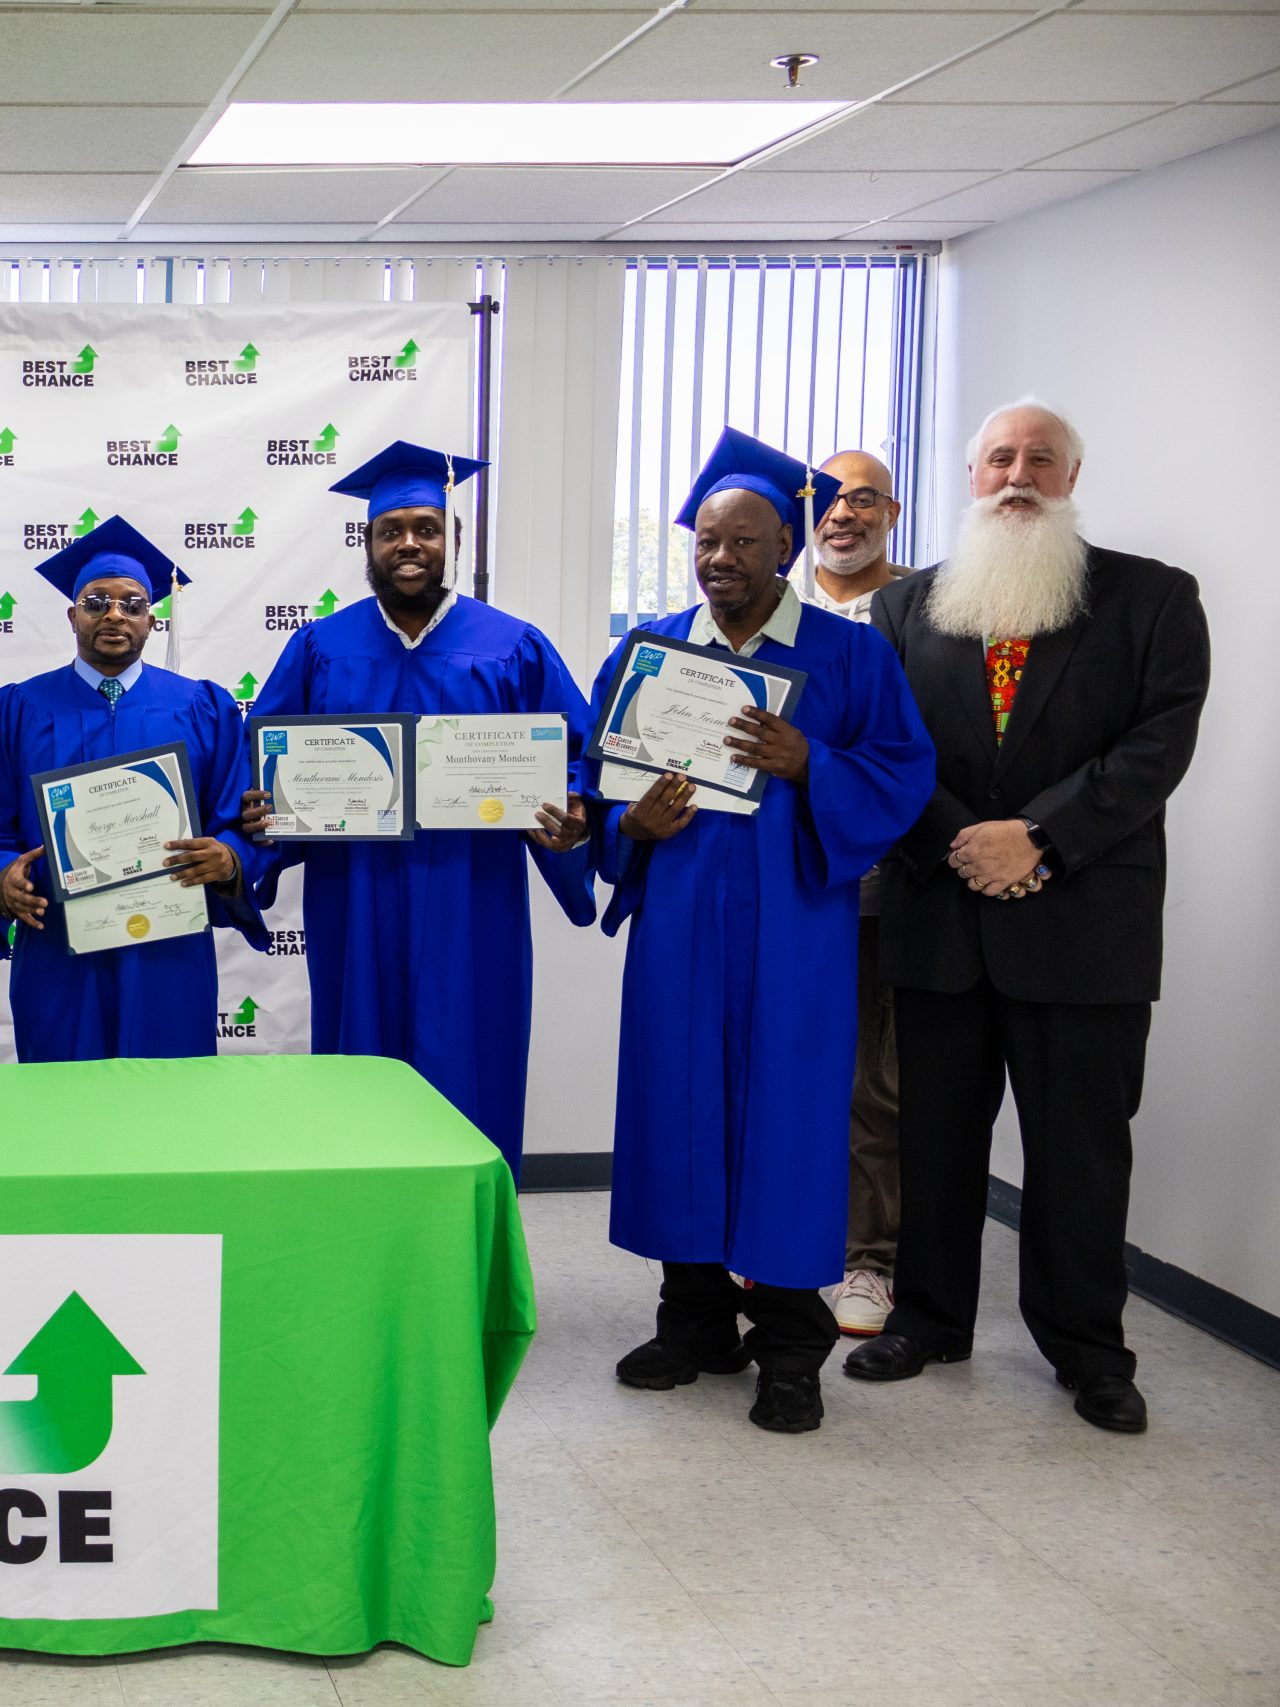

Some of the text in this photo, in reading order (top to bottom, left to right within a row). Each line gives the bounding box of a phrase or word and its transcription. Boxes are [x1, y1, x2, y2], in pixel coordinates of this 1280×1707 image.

[23, 361, 67, 373] BEST
[186, 360, 229, 373] BEST
[348, 356, 391, 368] BEST
[23, 375, 94, 387] CHANCE
[186, 373, 258, 385] CHANCE
[349, 369, 417, 381] CHANCE
[107, 440, 151, 453] BEST
[267, 440, 309, 452] BEST
[107, 454, 178, 466] CHANCE
[267, 453, 336, 465] CHANCE
[24, 524, 68, 536] BEST
[185, 523, 227, 535] BEST
[346, 522, 366, 534] BE
[24, 537, 81, 550] CHAN
[185, 536, 255, 548] CHANCE
[266, 605, 308, 617] BEST
[680, 667, 736, 688] CERTIFICATE
[660, 704, 692, 717] John
[454, 731, 526, 740] CERTIFICATE
[304, 738, 356, 746] CERTIFICATE
[446, 753, 537, 765] Monthovany Mondesir
[88, 776, 138, 794] CERTIFICATE
[120, 804, 161, 825] Marshall
